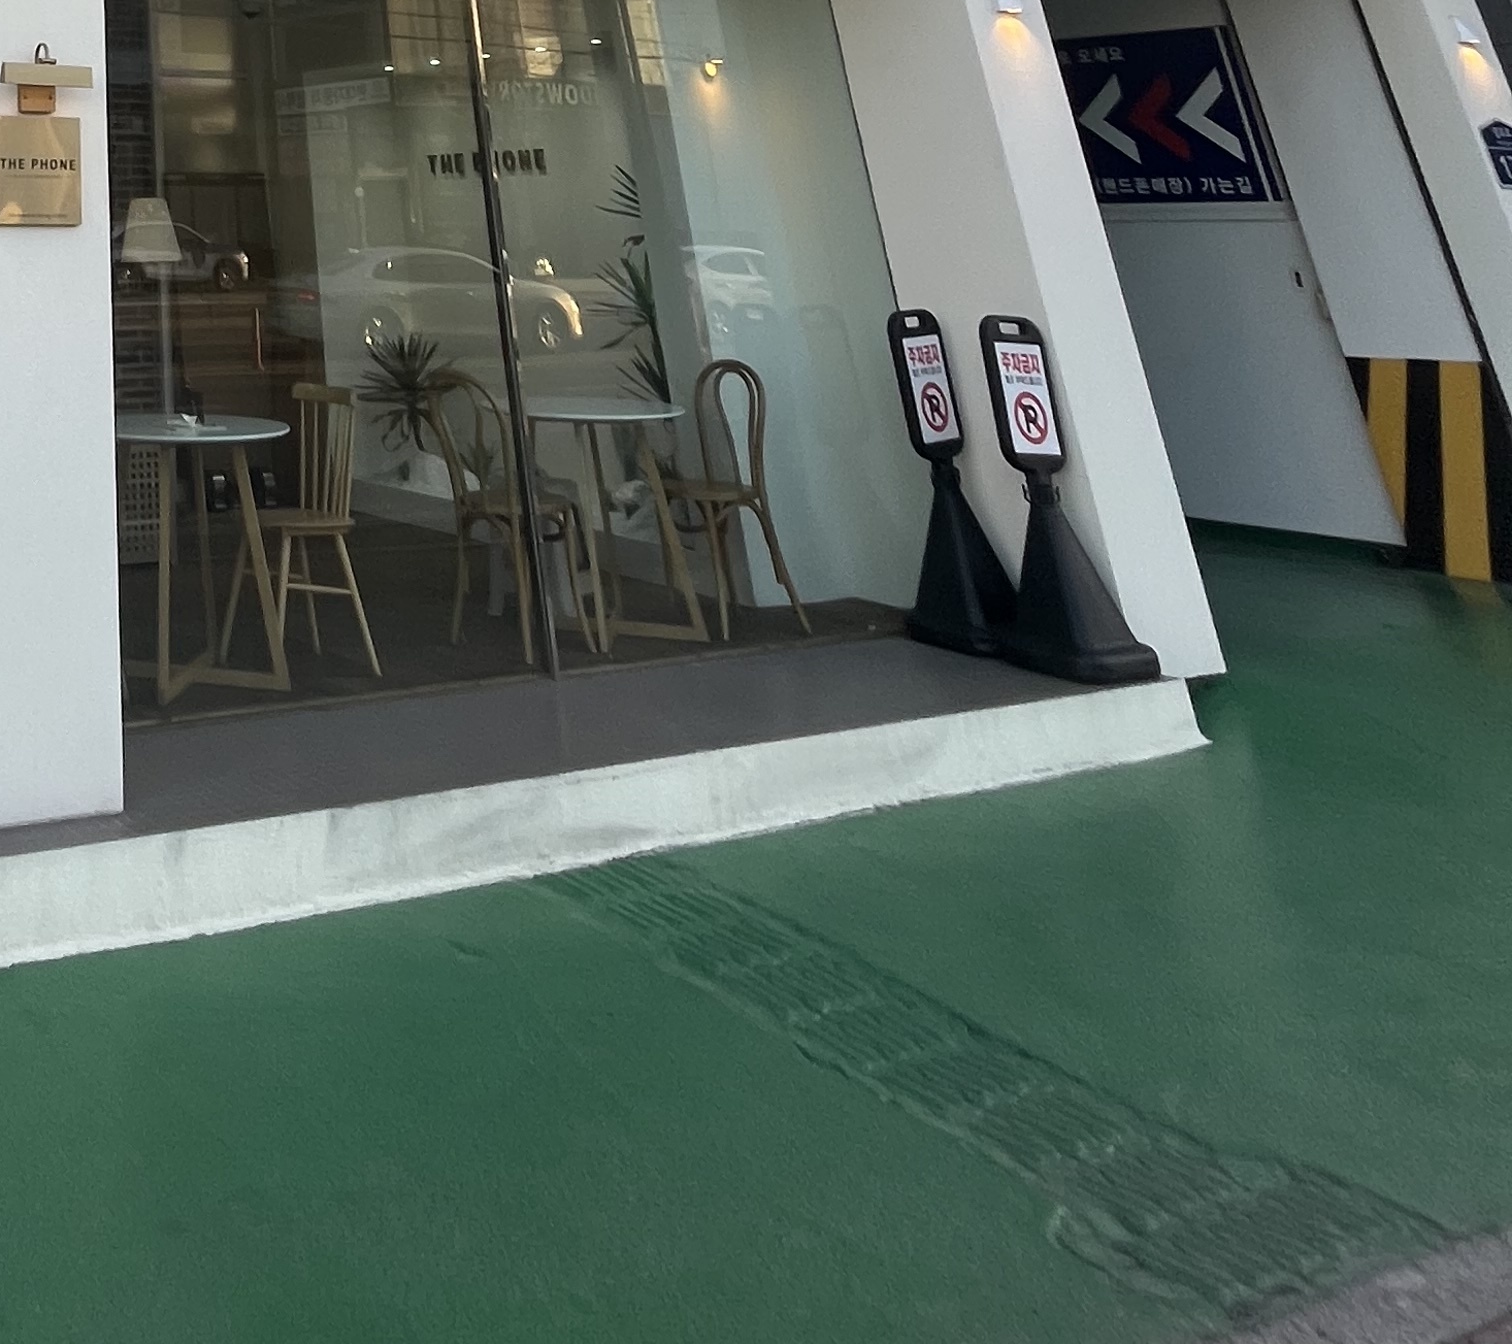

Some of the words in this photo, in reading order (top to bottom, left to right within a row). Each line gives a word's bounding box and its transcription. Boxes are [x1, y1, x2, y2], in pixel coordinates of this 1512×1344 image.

[0, 157, 25, 170] THE
[30, 157, 77, 172] PHONE
[426, 153, 465, 177] THE
[472, 148, 548, 176] PONE
[1200, 174, 1255, 195] 가는길
[907, 343, 941, 367] 주차금지
[1000, 351, 1041, 374] 주차금지
